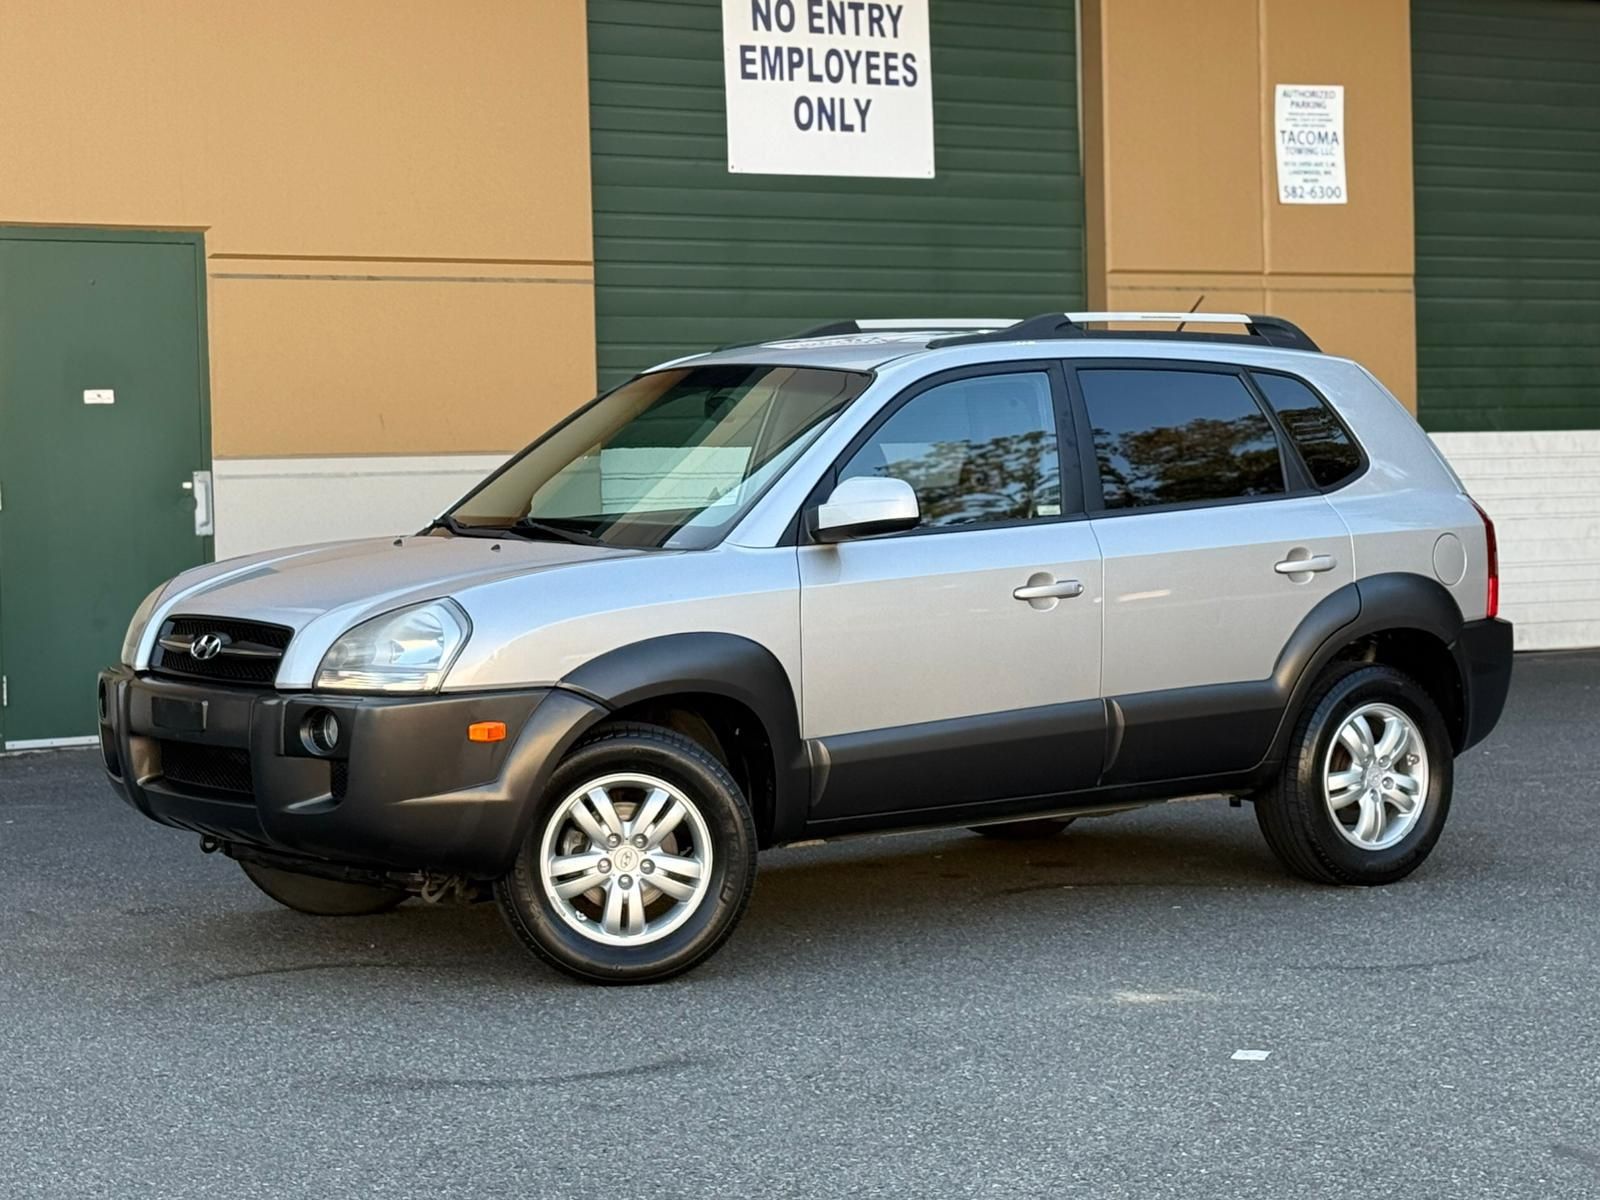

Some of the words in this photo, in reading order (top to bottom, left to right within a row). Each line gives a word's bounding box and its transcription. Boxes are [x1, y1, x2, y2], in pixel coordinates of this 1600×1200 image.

[751, 0, 795, 33] NO
[808, 0, 903, 38] ENTRY
[740, 45, 918, 87] EMPLOYEES
[1290, 100, 1327, 109] PARKING
[794, 96, 872, 133] ONLY
[1280, 130, 1339, 145] TACOMA
[1285, 147, 1318, 156] TOWING
[1284, 185, 1342, 199] 582-6300
